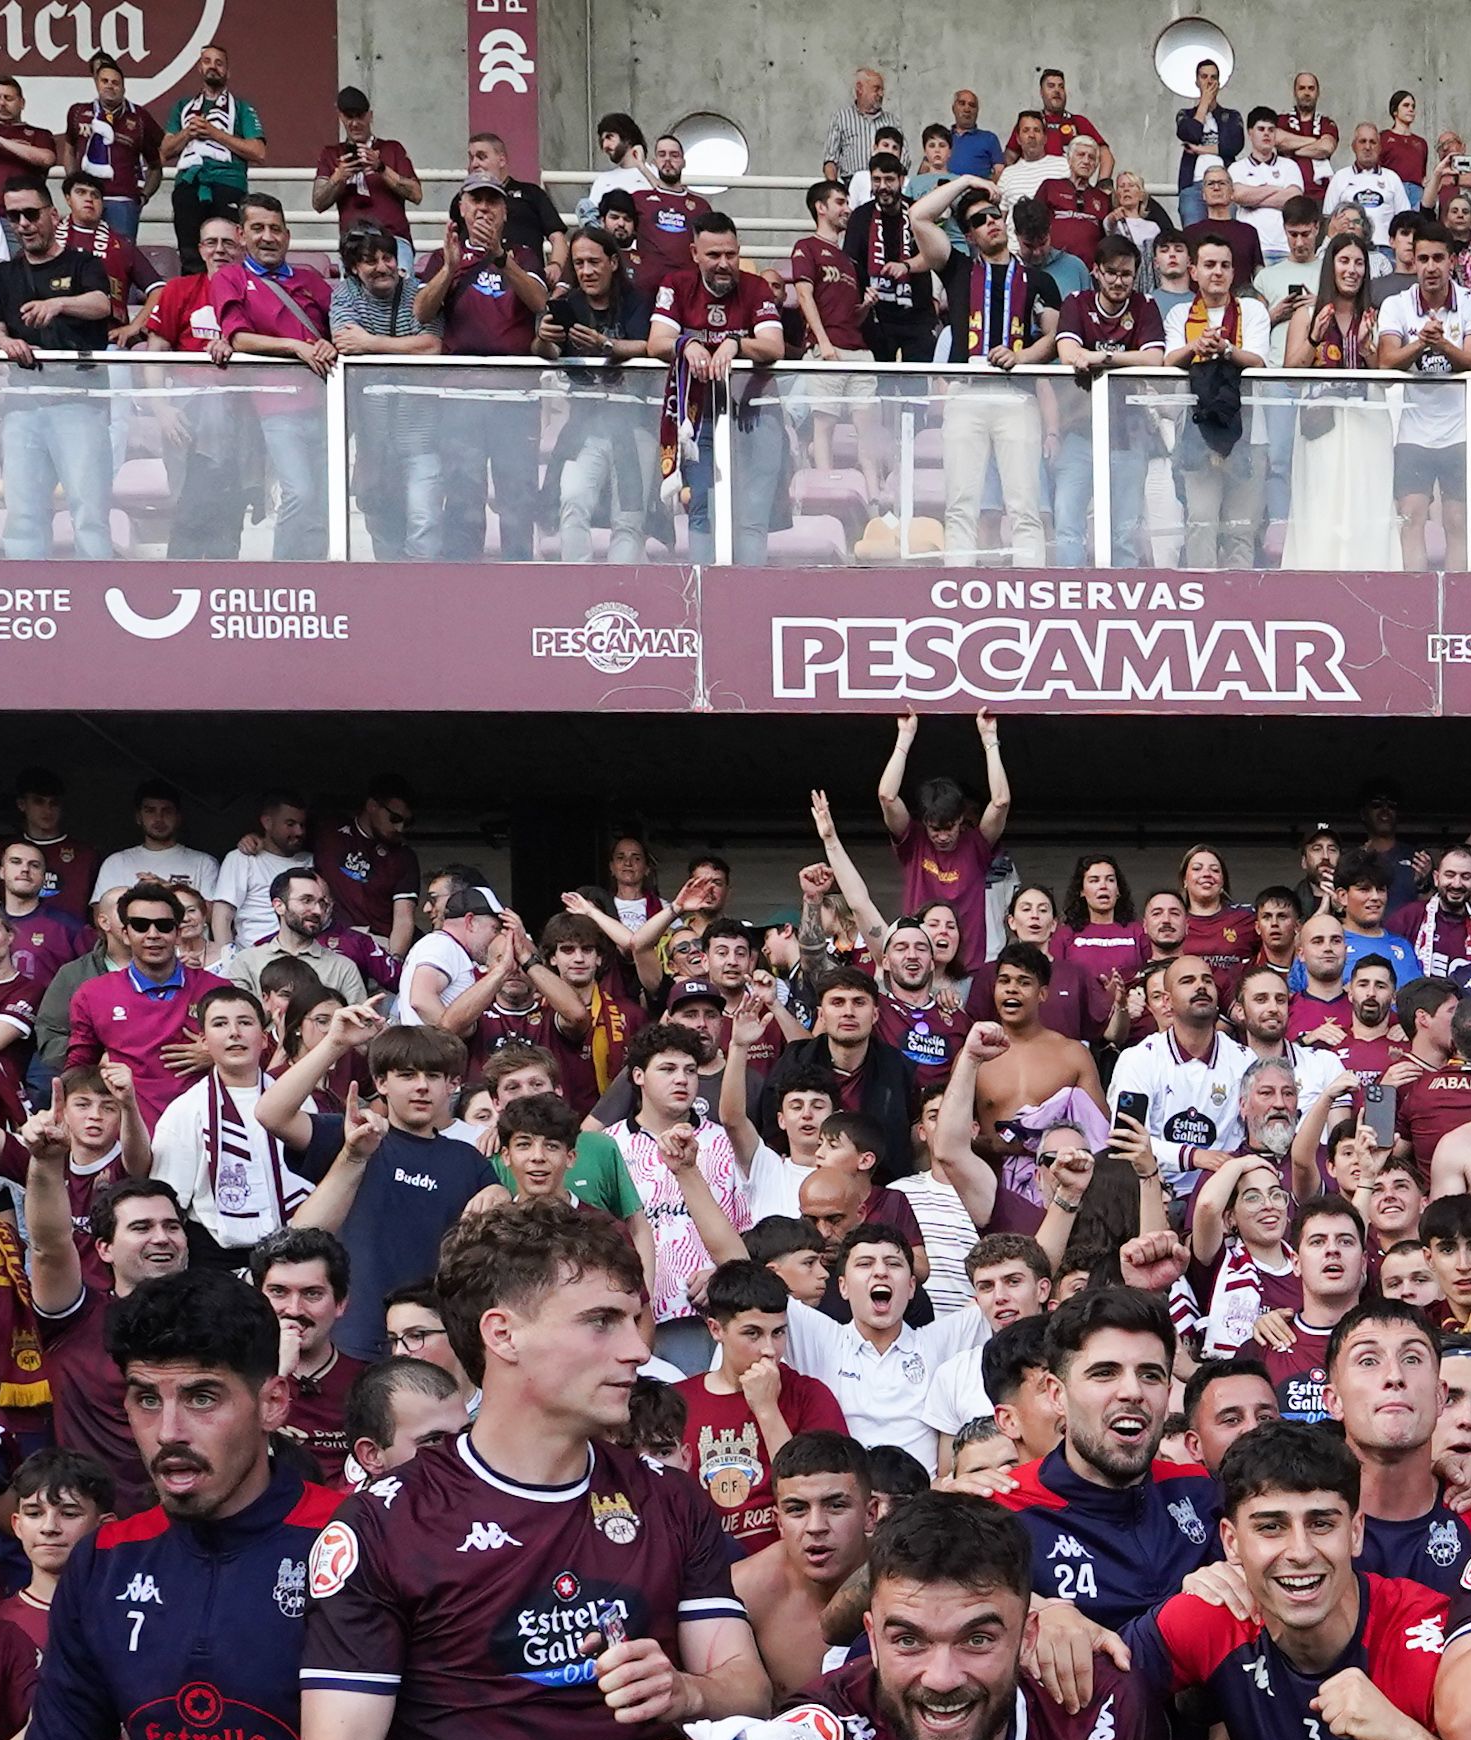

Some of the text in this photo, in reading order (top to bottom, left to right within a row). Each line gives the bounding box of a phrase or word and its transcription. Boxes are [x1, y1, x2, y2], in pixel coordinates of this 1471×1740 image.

[209, 588, 317, 614] GALICIA
[930, 580, 1206, 611] CONSERVAS
[209, 615, 349, 641] SAUDABLE
[530, 626, 700, 658] PESCAMAR
[771, 616, 1362, 703] PESCAMAR
[906, 1041, 946, 1058] Galicia
[1170, 1115, 1216, 1136] Estrella
[1170, 1129, 1213, 1144] Galicia
[393, 1166, 438, 1192] Buddy.
[704, 1453, 755, 1469] PONTEVEDRA
[1053, 1561, 1098, 1600] 24
[126, 1608, 147, 1653] 7
